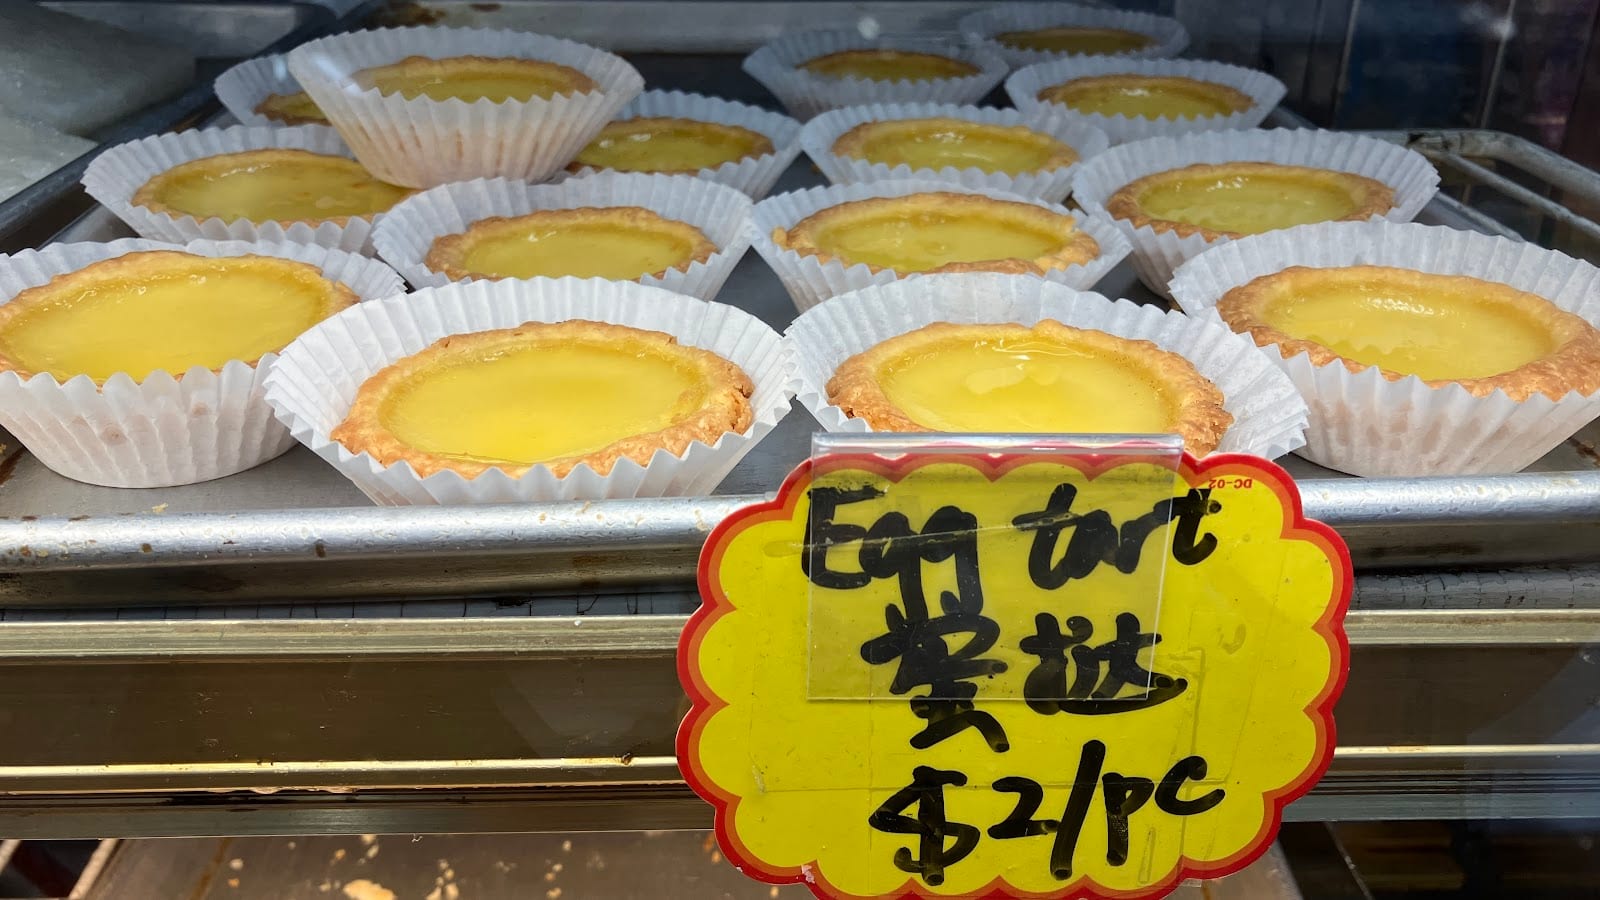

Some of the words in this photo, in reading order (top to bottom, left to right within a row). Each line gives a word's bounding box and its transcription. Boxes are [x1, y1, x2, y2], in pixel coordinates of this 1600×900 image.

[1208, 478, 1253, 489] DC-02
[801, 484, 985, 617] Egg
[1011, 484, 1222, 589] tart
